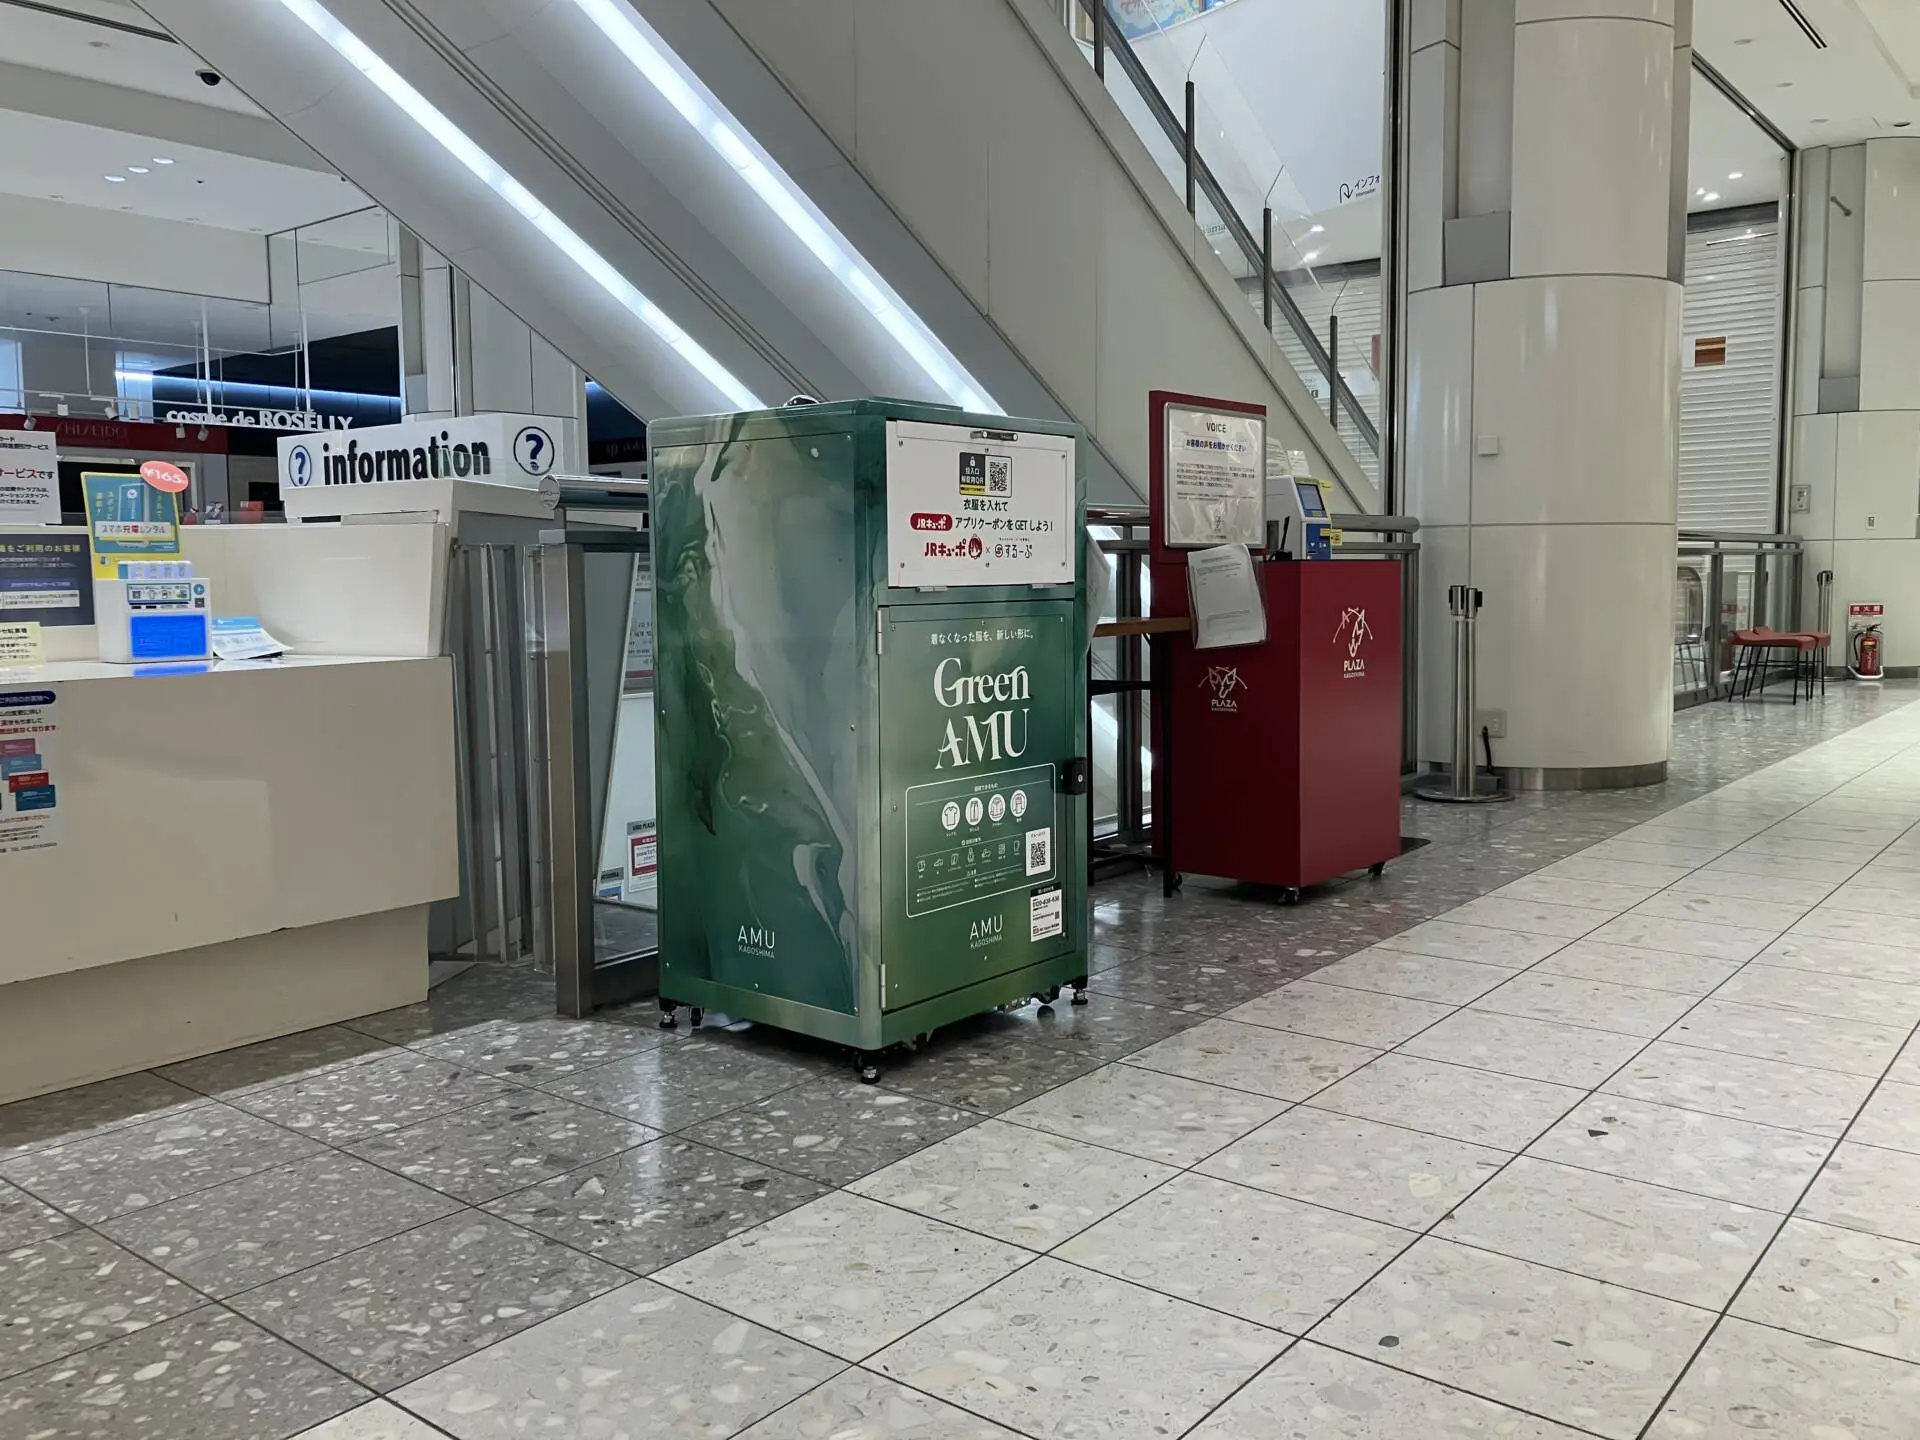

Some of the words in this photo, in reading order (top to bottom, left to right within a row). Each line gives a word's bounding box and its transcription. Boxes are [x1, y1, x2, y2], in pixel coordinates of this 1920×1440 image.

[232, 411, 255, 426] de
[1206, 421, 1227, 434] VOICE
[323, 430, 492, 485] information
[963, 499, 1009, 512] 衣服を入れて
[1343, 658, 1365, 672] PLAZA
[933, 656, 1032, 708] Green
[1211, 699, 1237, 709] PLAZA
[934, 708, 1031, 770] AMU
[969, 914, 1003, 941] AMU
[737, 924, 775, 949] AMU
[970, 933, 1003, 949] KAGOSHIMA
[738, 943, 775, 959] KAGOSHIMA
